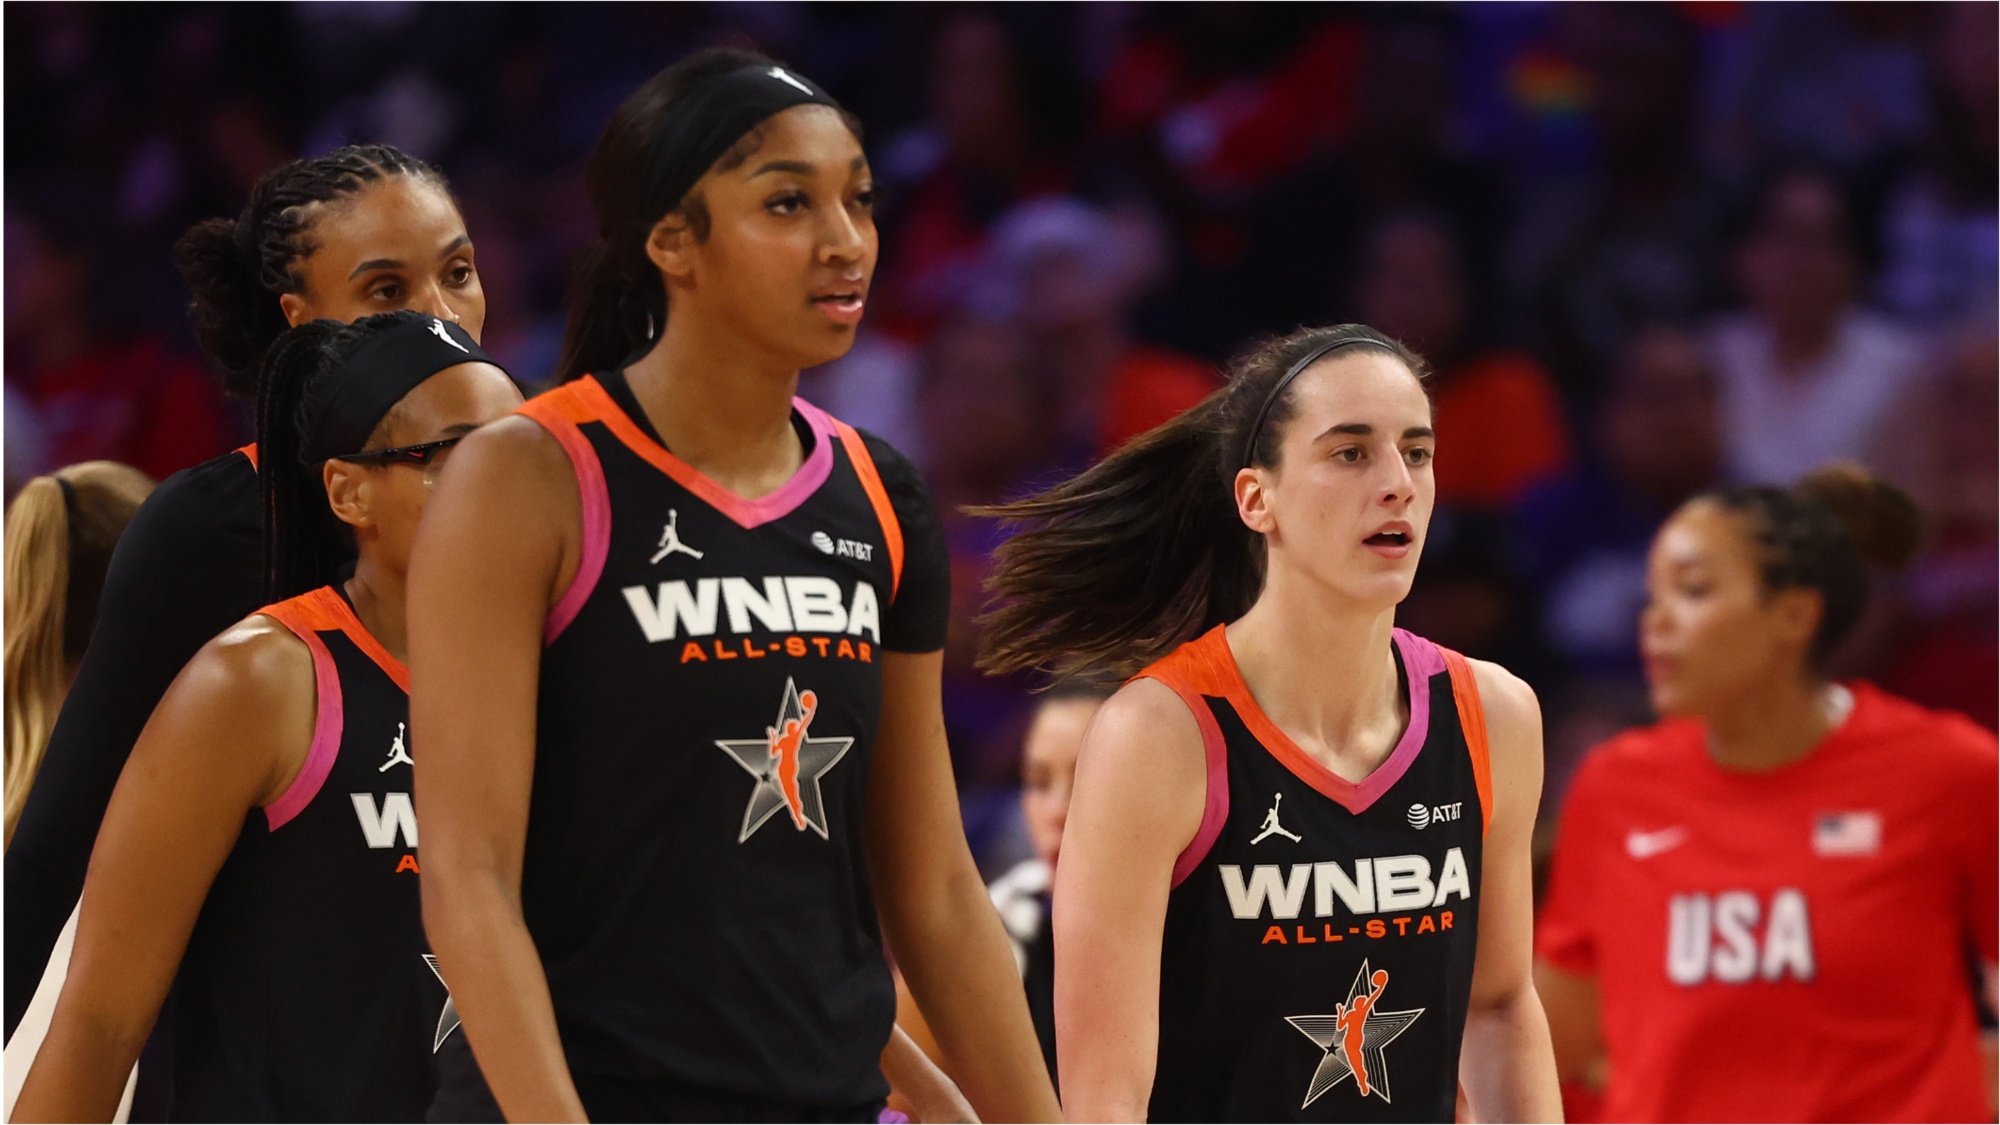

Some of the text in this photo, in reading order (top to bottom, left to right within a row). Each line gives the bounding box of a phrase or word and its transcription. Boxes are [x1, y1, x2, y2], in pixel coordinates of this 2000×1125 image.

[836, 538, 873, 561] AT&T
[622, 576, 880, 643] WNBA
[680, 636, 872, 664] ALL-STAR
[1432, 802, 1462, 823] AT&T
[1218, 846, 1471, 919] WNBA
[1262, 911, 1454, 944] ALL-STAR
[1666, 887, 1816, 986] USA
